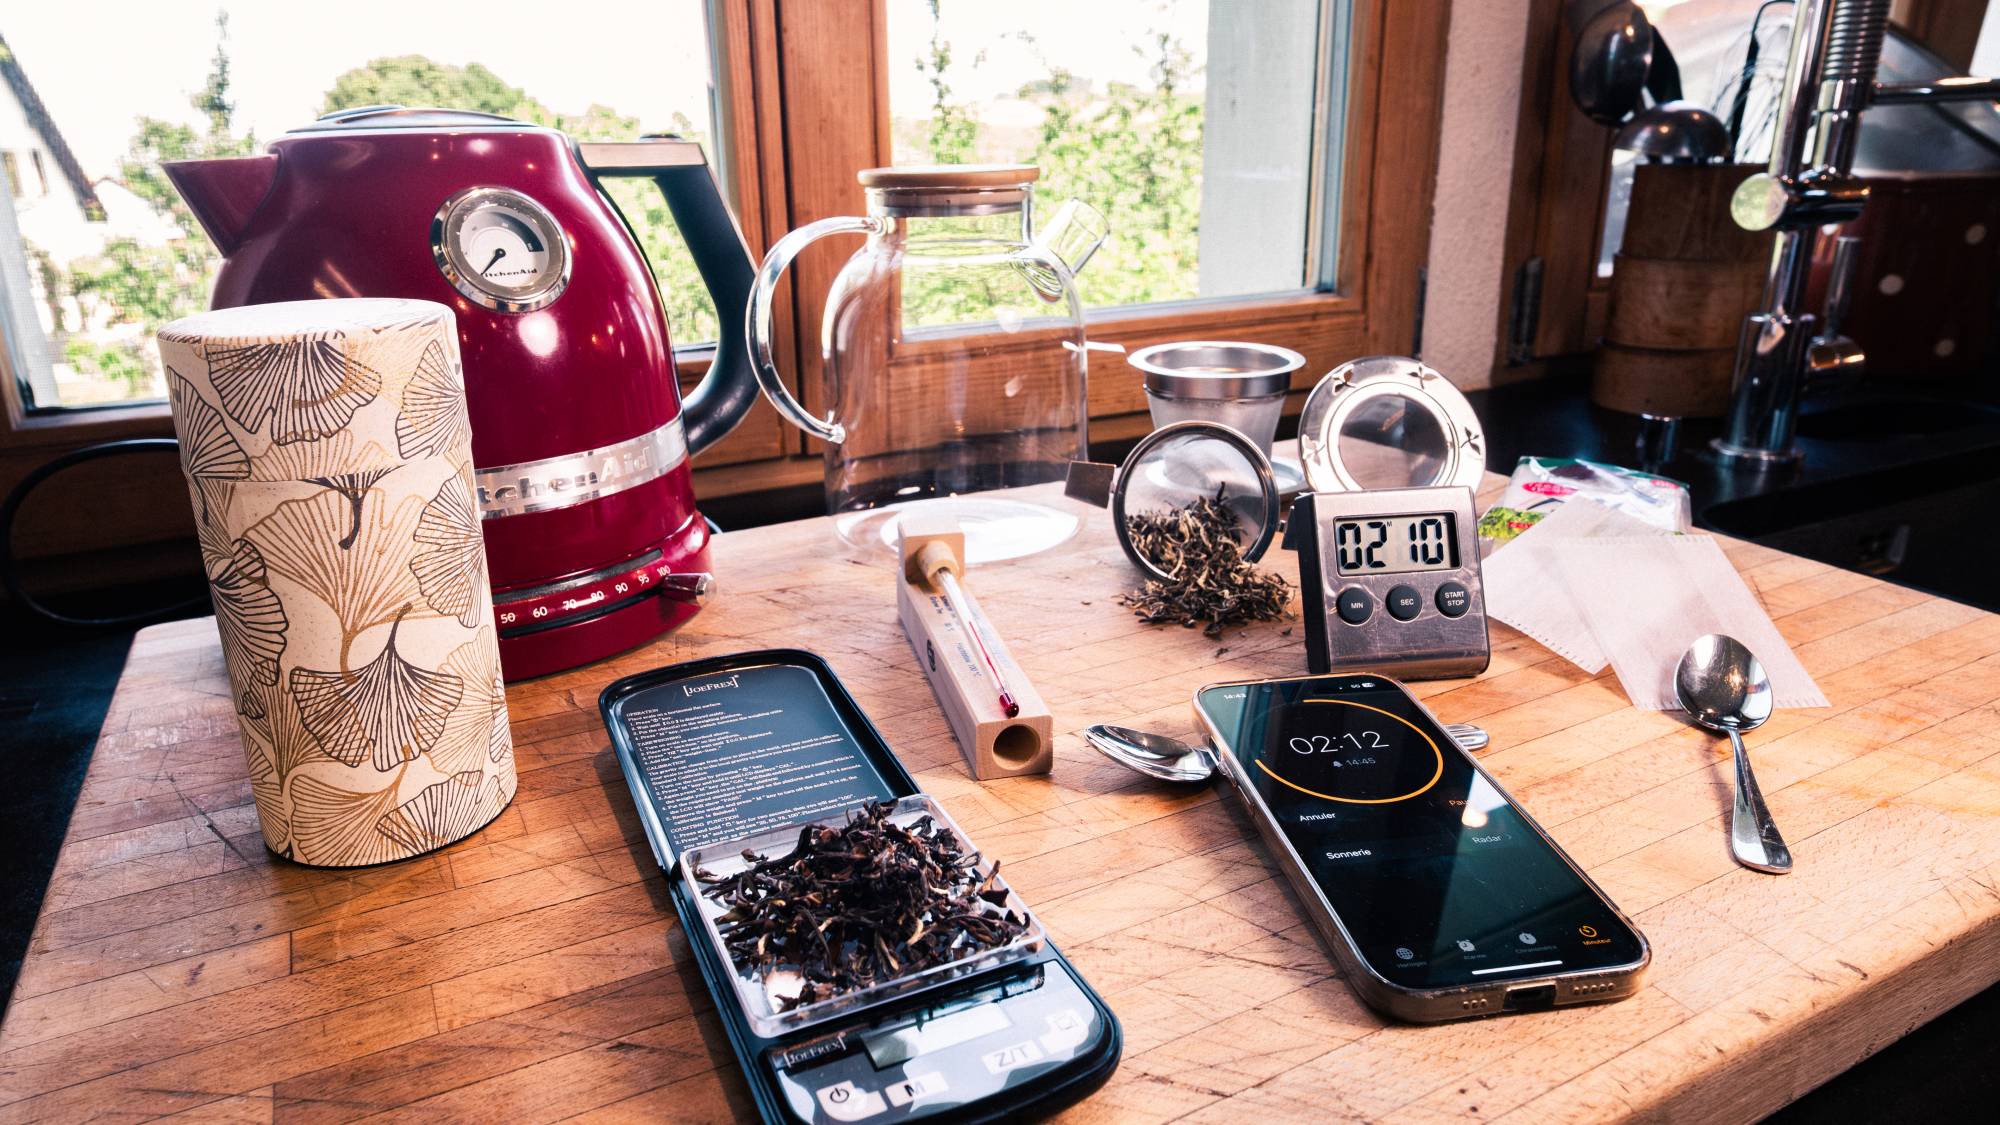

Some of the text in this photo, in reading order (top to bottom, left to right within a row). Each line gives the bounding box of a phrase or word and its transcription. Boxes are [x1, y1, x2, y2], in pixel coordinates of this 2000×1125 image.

[1338, 521, 1387, 570] 02
[1409, 518, 1444, 564] 10
[500, 565, 670, 624] 50 60 70 80 90 95 100
[1290, 731, 1390, 754] 02:12
[1346, 758, 1376, 766] 14:45
[1300, 812, 1336, 822] Annuler
[1326, 835, 1500, 860] Sonnerie Radar
